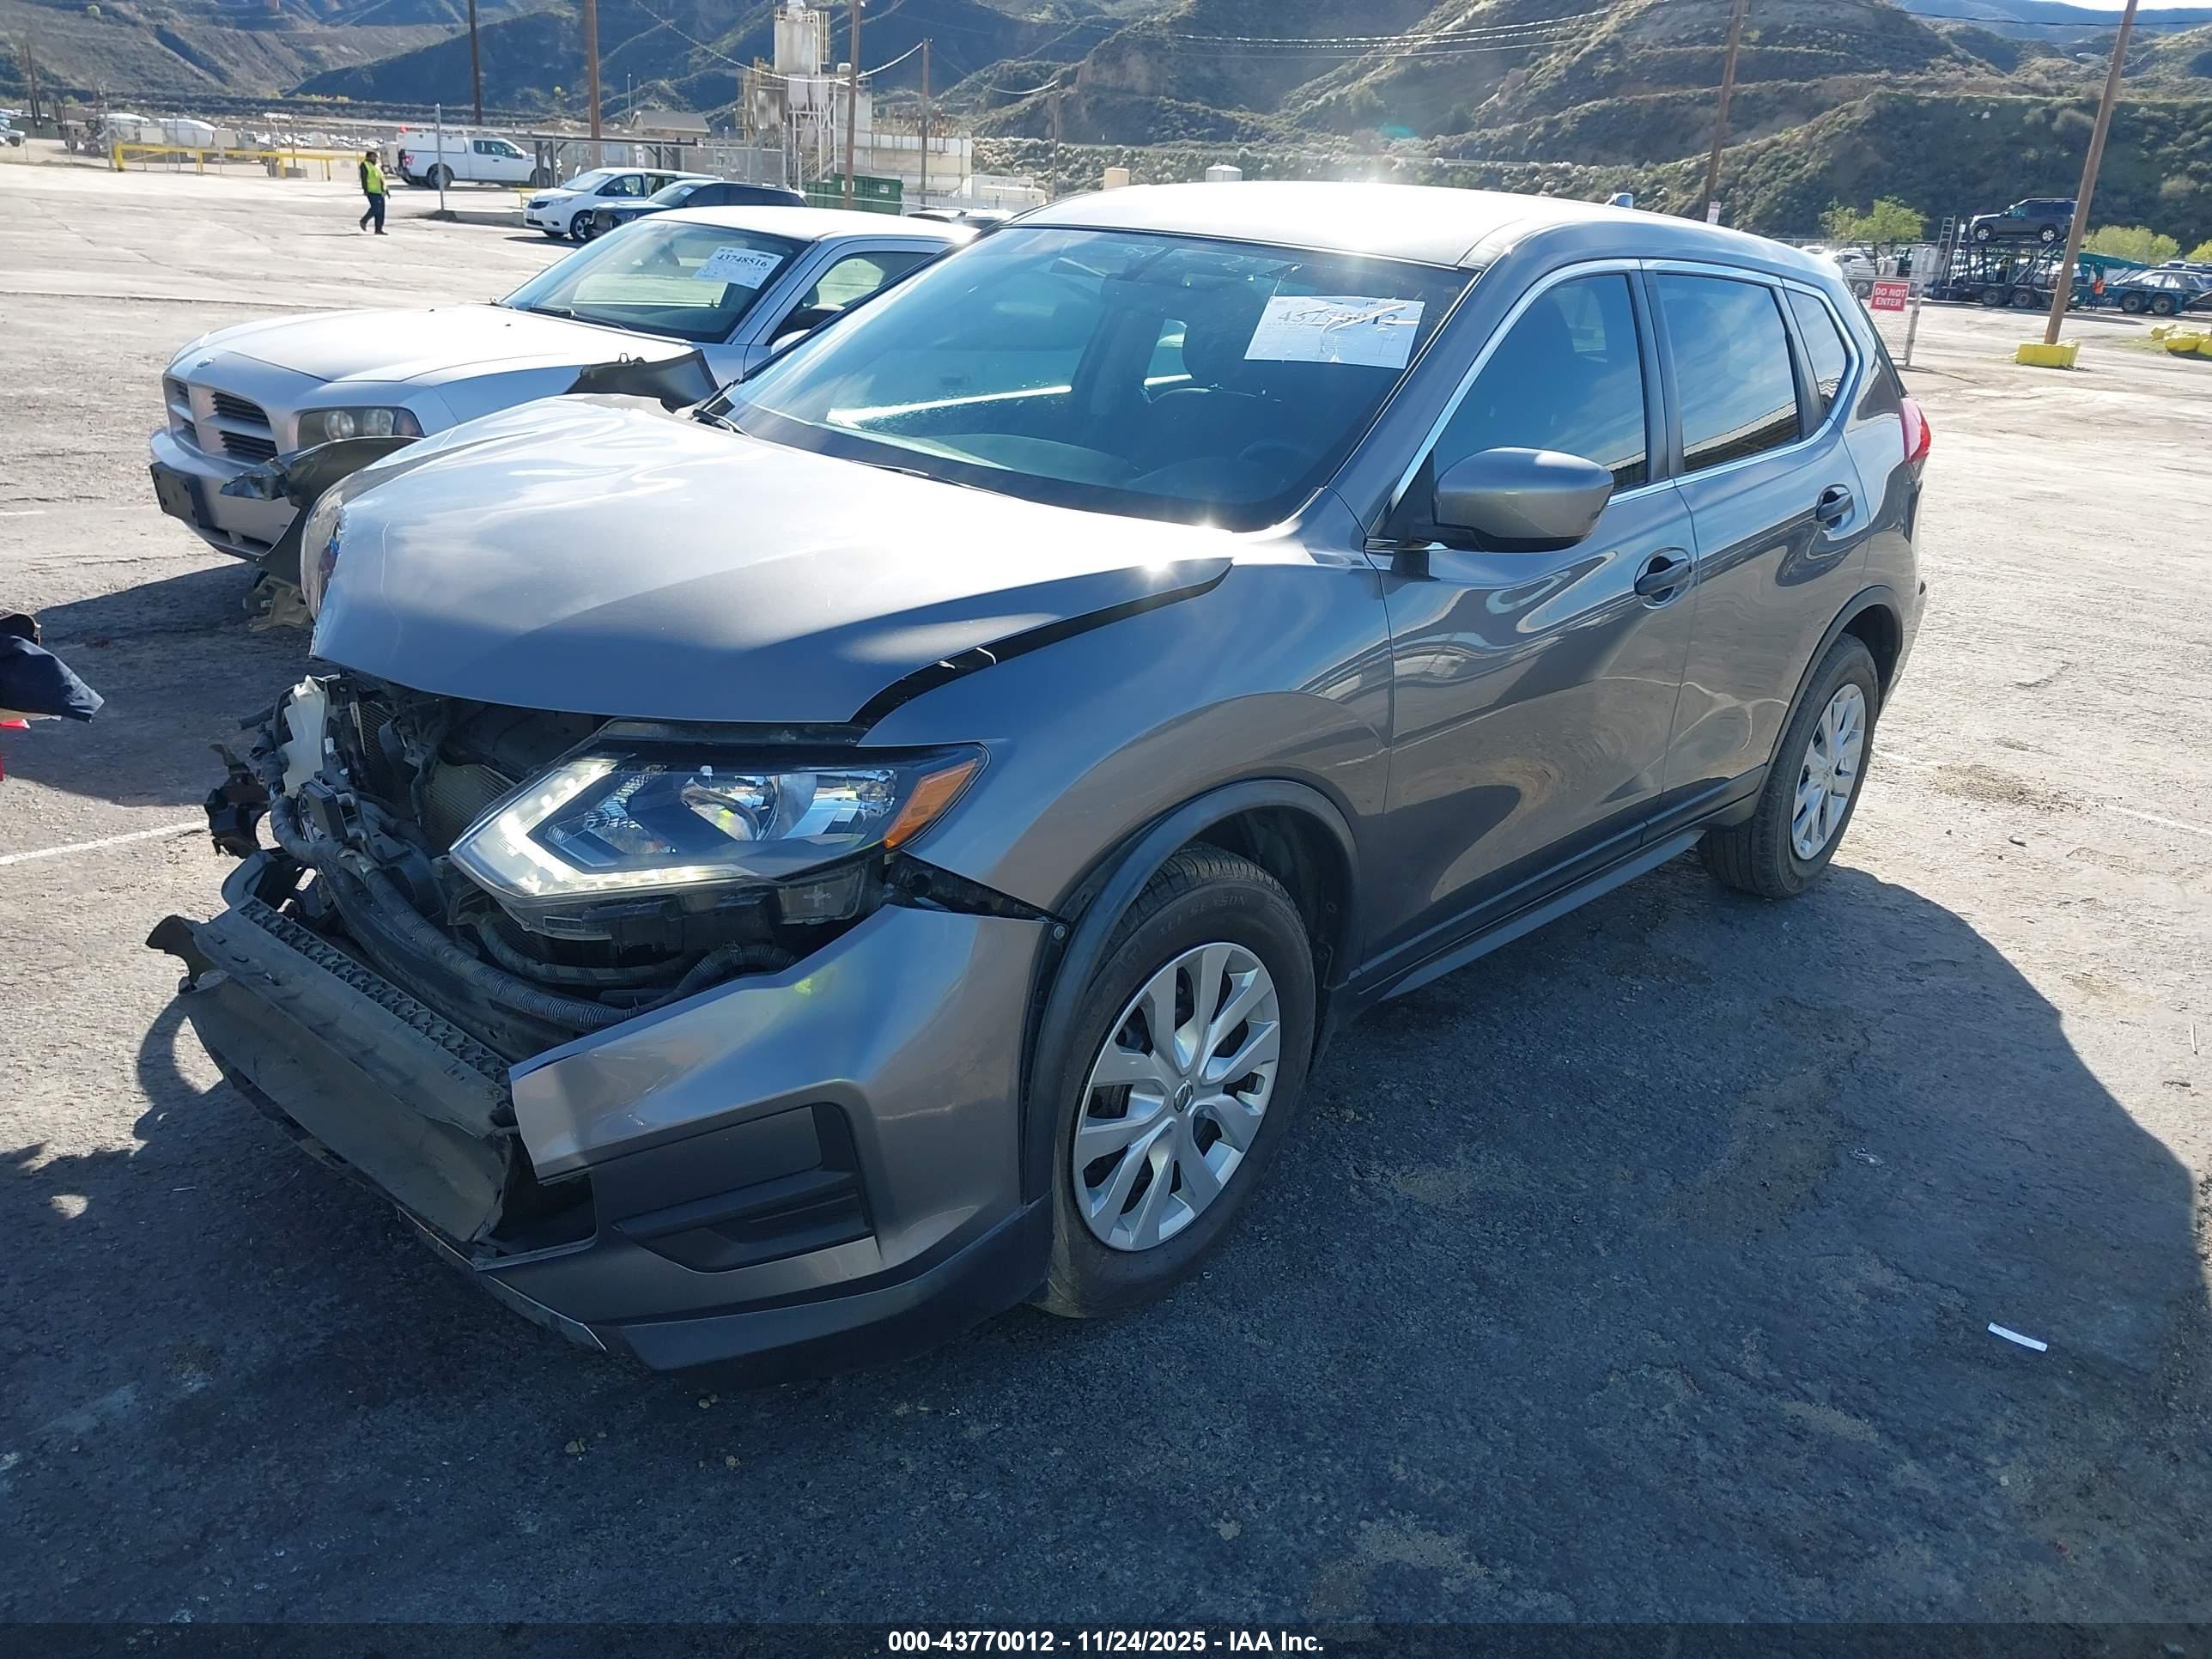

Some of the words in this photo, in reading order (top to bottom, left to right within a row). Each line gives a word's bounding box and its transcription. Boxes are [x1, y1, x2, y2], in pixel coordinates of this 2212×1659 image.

[716, 253, 768, 268] 43748516
[1875, 287, 1887, 296] DO
[1888, 288, 1906, 297] NOT
[1875, 296, 1902, 307] ENTER
